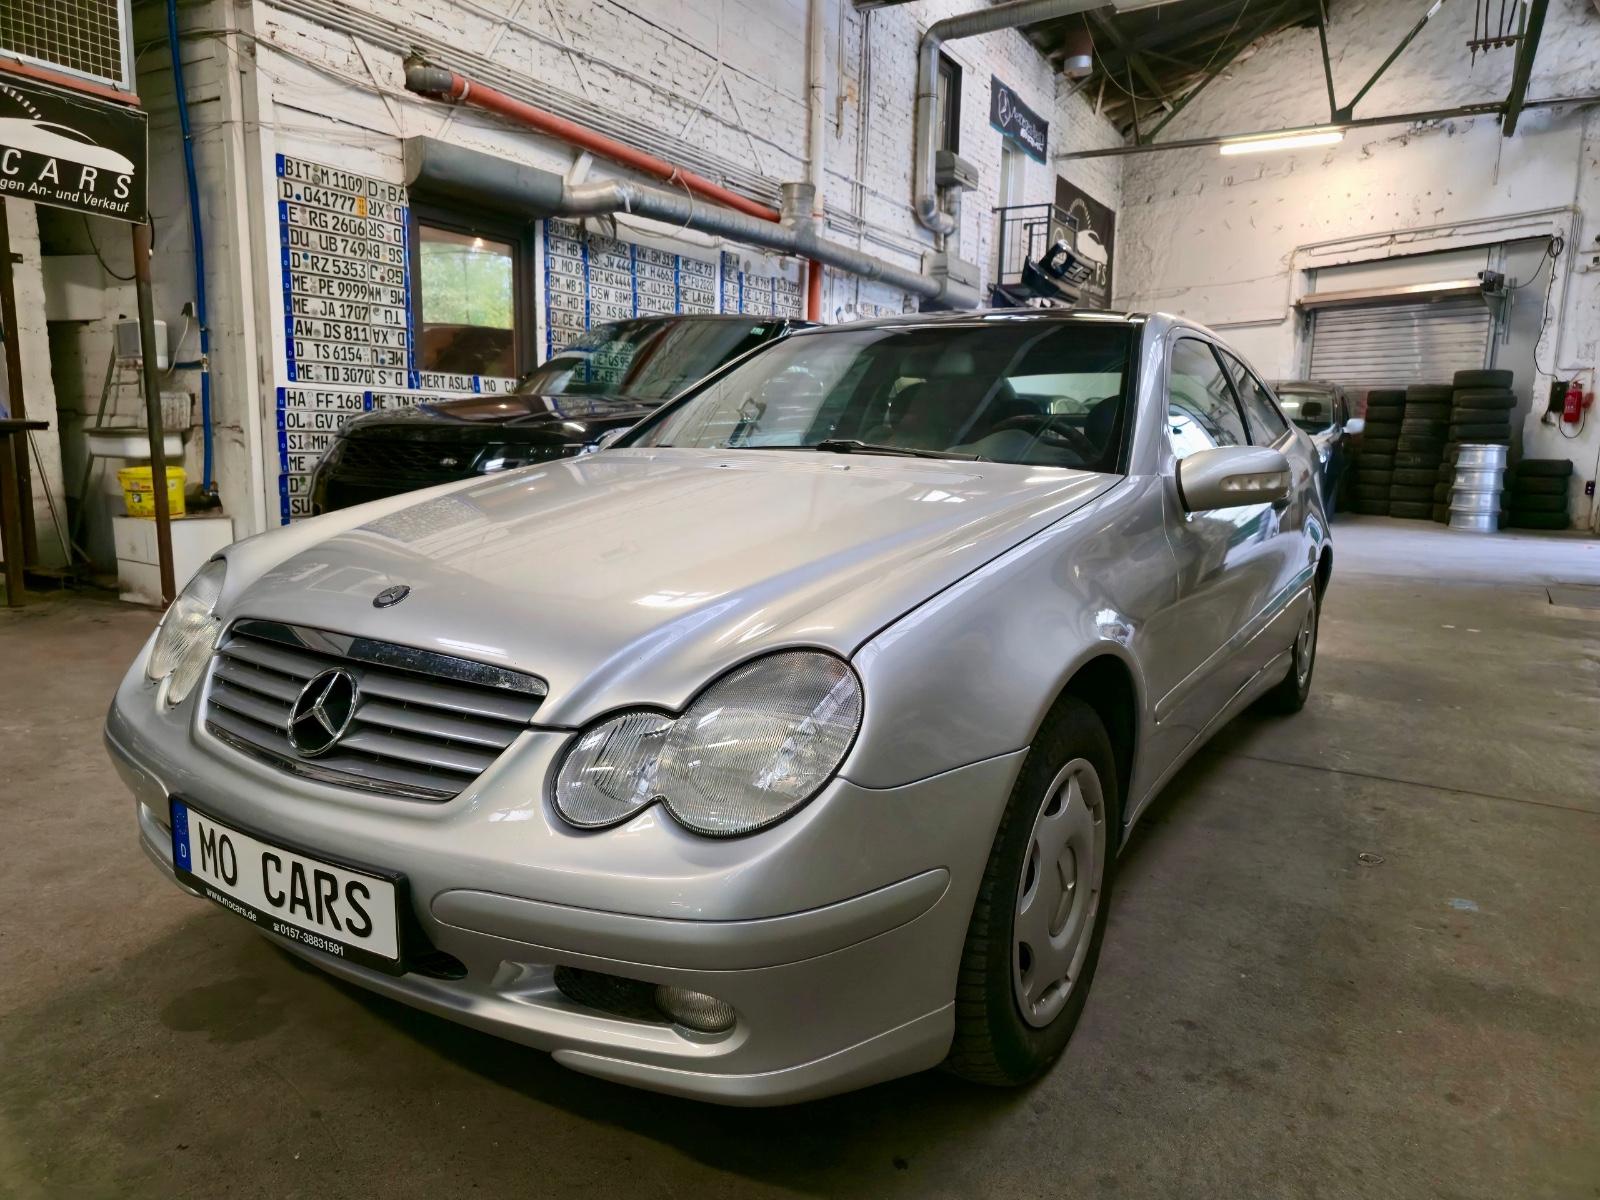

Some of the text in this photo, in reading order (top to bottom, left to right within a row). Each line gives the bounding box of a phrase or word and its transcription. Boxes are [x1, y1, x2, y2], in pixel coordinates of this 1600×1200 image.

[2, 148, 132, 199] CARS
[285, 158, 363, 193] BIT M 1109
[28, 181, 53, 196] An-
[56, 189, 80, 203] und
[83, 192, 130, 214] Verkauf
[282, 181, 293, 199] D
[303, 186, 356, 212] 041777
[288, 206, 365, 237] E RG 2606
[393, 207, 402, 223] D
[289, 229, 366, 257] DU UB 749
[393, 228, 401, 243] D
[291, 252, 366, 279] D RZ 5353
[388, 247, 403, 264] SG
[292, 274, 309, 292] ME
[318, 277, 335, 296] PE
[337, 281, 368, 300] 9999
[390, 289, 405, 306] MG
[292, 297, 369, 321] ME JA 1707
[294, 319, 370, 343] AW DS 811
[397, 331, 406, 347] D
[295, 341, 304, 357] D
[313, 343, 330, 360] TS
[333, 345, 363, 363] 6154
[387, 350, 404, 366] ME
[297, 363, 314, 380] ME
[323, 365, 340, 382] TD
[342, 367, 372, 384] 3070
[420, 373, 446, 389] MERT
[483, 379, 497, 393] MO
[287, 390, 362, 410] HA FF 168
[372, 393, 387, 409] ME
[286, 412, 306, 429] OL
[315, 413, 334, 429] GV
[288, 434, 329, 450] SI MH
[289, 456, 306, 472] ME
[289, 477, 299, 493] D
[291, 498, 311, 515] SU
[180, 821, 372, 938] D MO CARS
[205, 887, 258, 922] www.mocars.de
[280, 924, 344, 957] 0157-38831591
